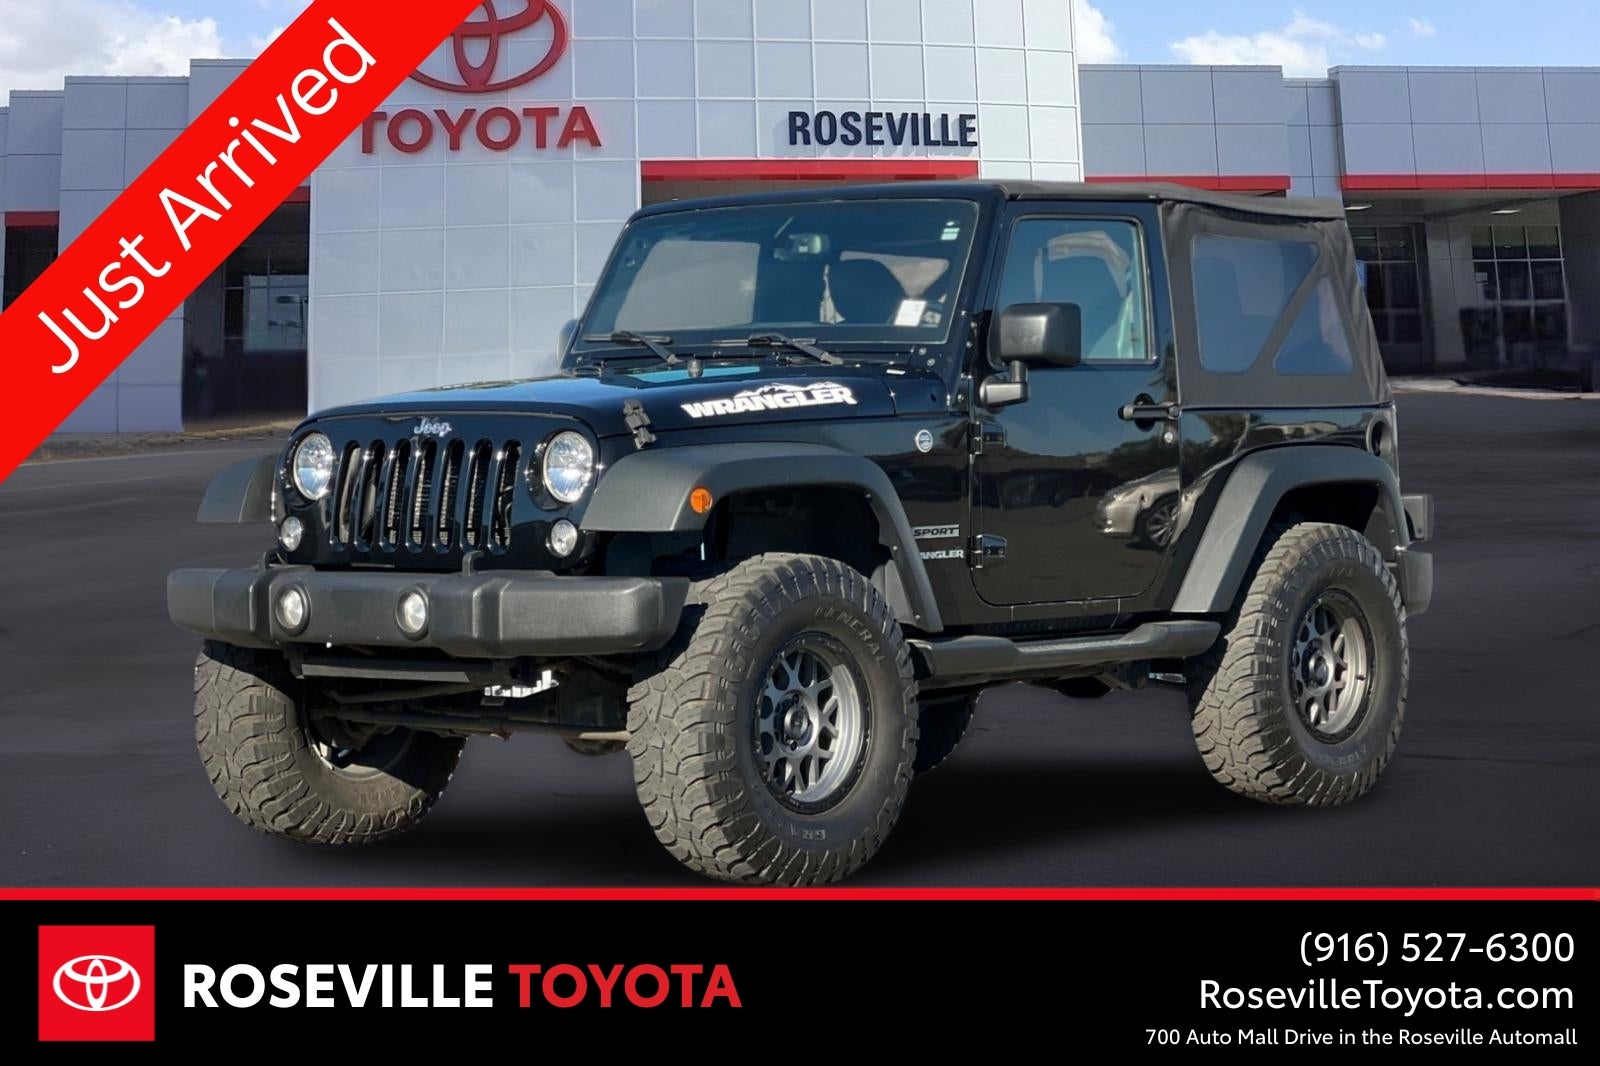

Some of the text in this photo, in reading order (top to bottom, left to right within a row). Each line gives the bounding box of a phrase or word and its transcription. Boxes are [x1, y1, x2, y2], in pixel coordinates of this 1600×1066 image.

[361, 106, 602, 153] TOYOTA
[788, 111, 978, 147] ROSEVILLE
[680, 386, 858, 418] WRANGLER
[413, 417, 453, 437] Jeep
[913, 527, 959, 537] SPORT
[919, 549, 965, 560] ANGLER
[815, 606, 886, 668] NERAL
